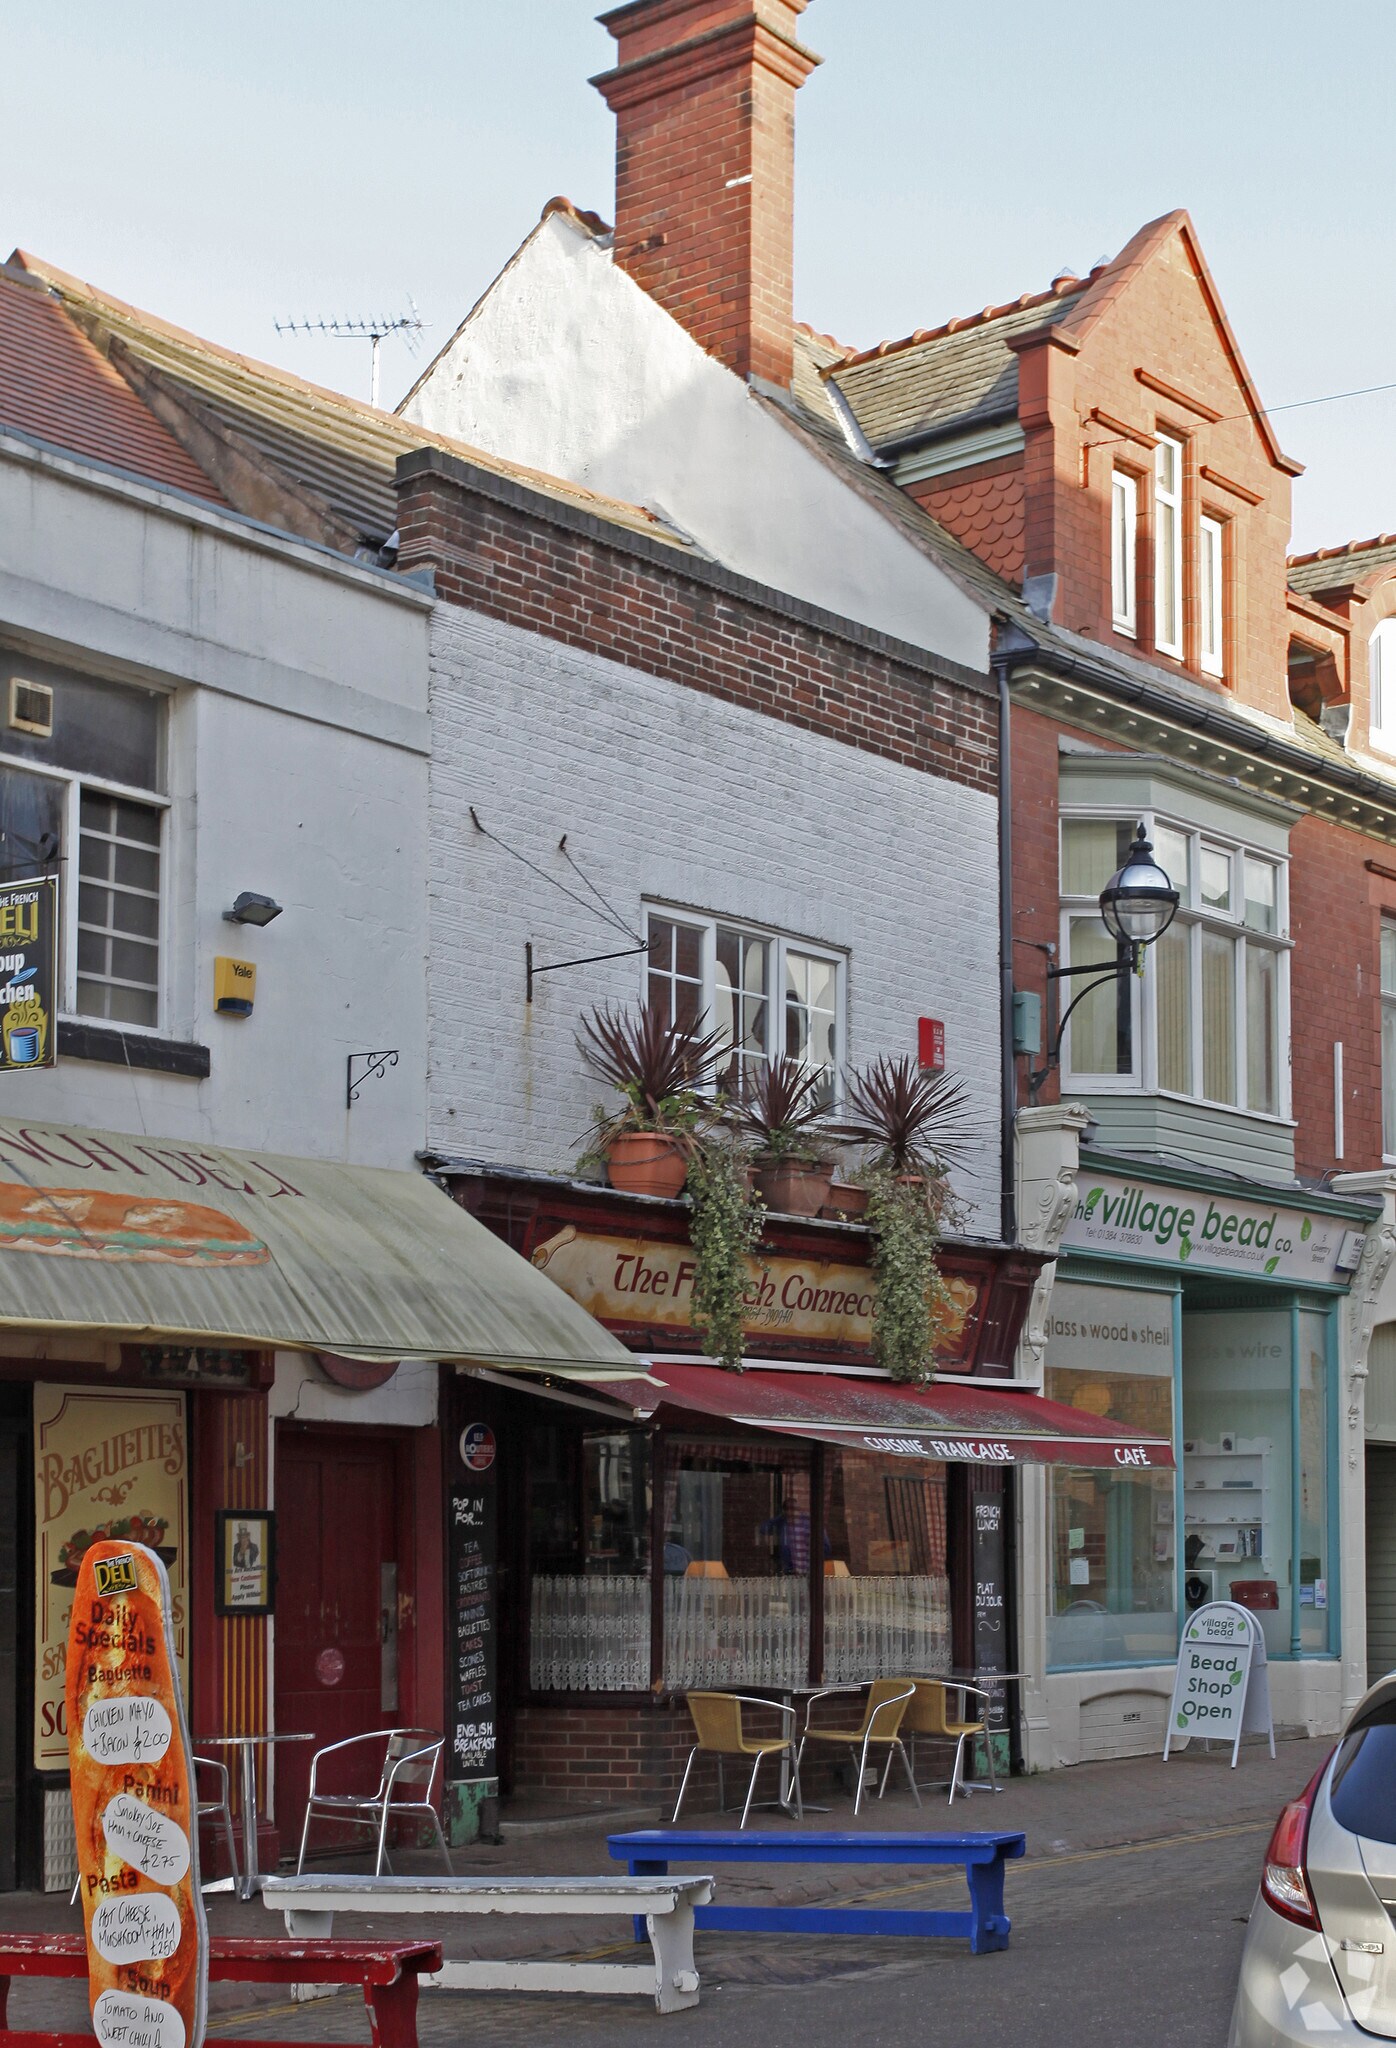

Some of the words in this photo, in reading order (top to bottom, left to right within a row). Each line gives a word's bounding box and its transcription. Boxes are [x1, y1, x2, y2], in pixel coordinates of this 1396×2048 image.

[10, 891, 39, 906] FRENCH
[232, 963, 253, 979] Yale
[1070, 1199, 1094, 1221] he
[1103, 1186, 1196, 1245] village
[1201, 1201, 1278, 1249] bead
[1274, 1237, 1294, 1254] co.
[614, 1253, 669, 1296] The
[671, 1260, 776, 1308] Fch
[781, 1274, 888, 1318] Connec
[1090, 1323, 1129, 1342] wood
[1140, 1325, 1170, 1346] shell
[1240, 1341, 1282, 1359] wire
[863, 1436, 929, 1455] CUISINE
[930, 1440, 1015, 1461] FRANCAISE
[1114, 1445, 1151, 1465] CAFÉ
[37, 1421, 184, 1524] BAGUETTES
[453, 1497, 469, 1511] POP
[473, 1498, 484, 1512] IN
[975, 1504, 1000, 1519] FRENCH
[976, 1518, 999, 1531] LUNCH
[464, 1540, 480, 1553] TEA
[95, 1562, 135, 1593] DELI
[976, 1582, 995, 1595] PLAT
[92, 1601, 138, 1633] Daily
[1201, 1618, 1235, 1630] village
[458, 1618, 491, 1638] BAGUETTES
[1207, 1626, 1234, 1637] bead
[76, 1622, 155, 1655] Specials
[1191, 1654, 1238, 1672] Bead
[88, 1664, 152, 1686] Baguette
[460, 1665, 487, 1682] WAFFLES
[1188, 1677, 1233, 1698] Shop
[457, 1698, 471, 1712] TEA
[1182, 1700, 1232, 1720] Open
[88, 1706, 124, 1732] CHICKEN
[129, 1701, 155, 1722] MAYO
[456, 1722, 493, 1738] ENGLISH
[99, 1732, 129, 1757] BACON
[453, 1737, 497, 1753] BREAKFAST
[124, 1774, 179, 1806] Panini
[87, 1870, 138, 1897] Pasta
[152, 1922, 175, 1940] HAM
[127, 1969, 170, 2000] Soup
[101, 1995, 137, 2020] TOMATO
[144, 2006, 165, 2024] AND
